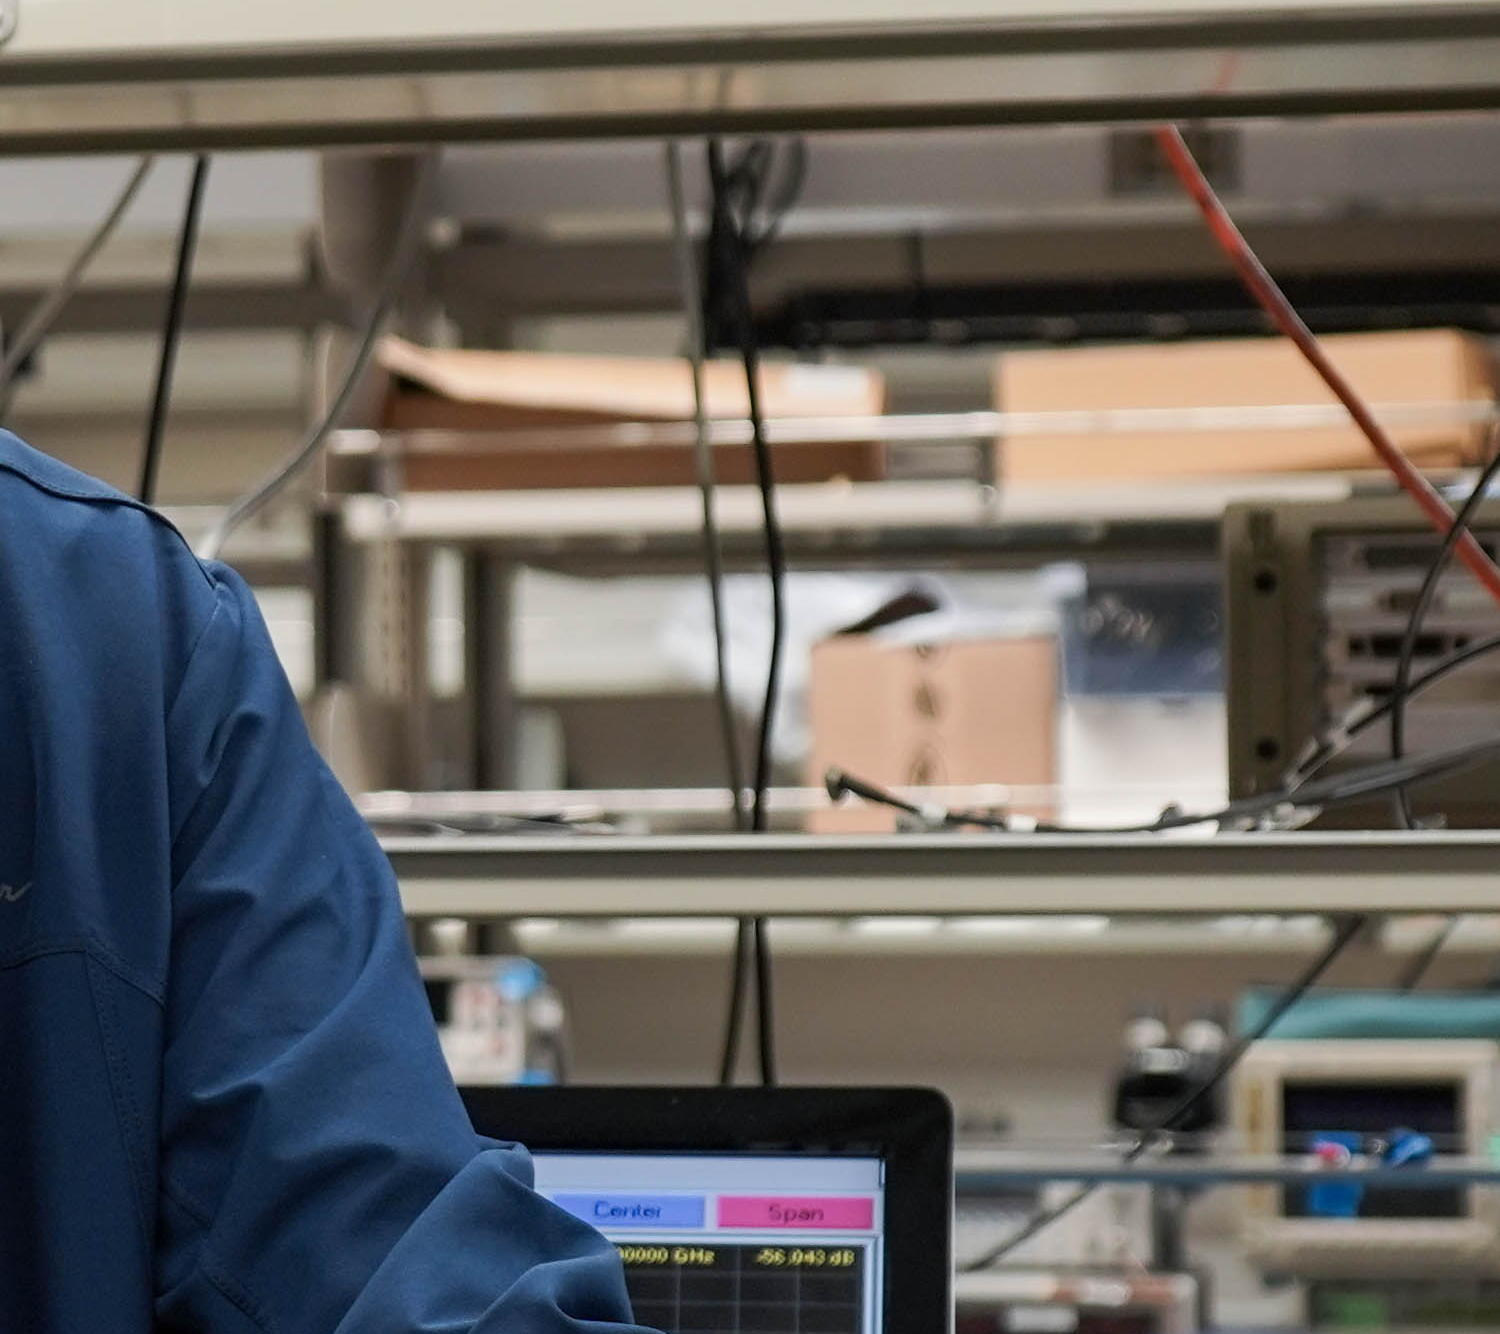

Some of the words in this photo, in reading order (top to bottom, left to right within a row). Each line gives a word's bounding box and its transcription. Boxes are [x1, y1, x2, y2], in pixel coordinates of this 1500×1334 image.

[593, 1200, 663, 1220] Center
[768, 1203, 825, 1224] Span
[674, 1247, 715, 1265] GHz
[830, 1248, 856, 1266] dB
